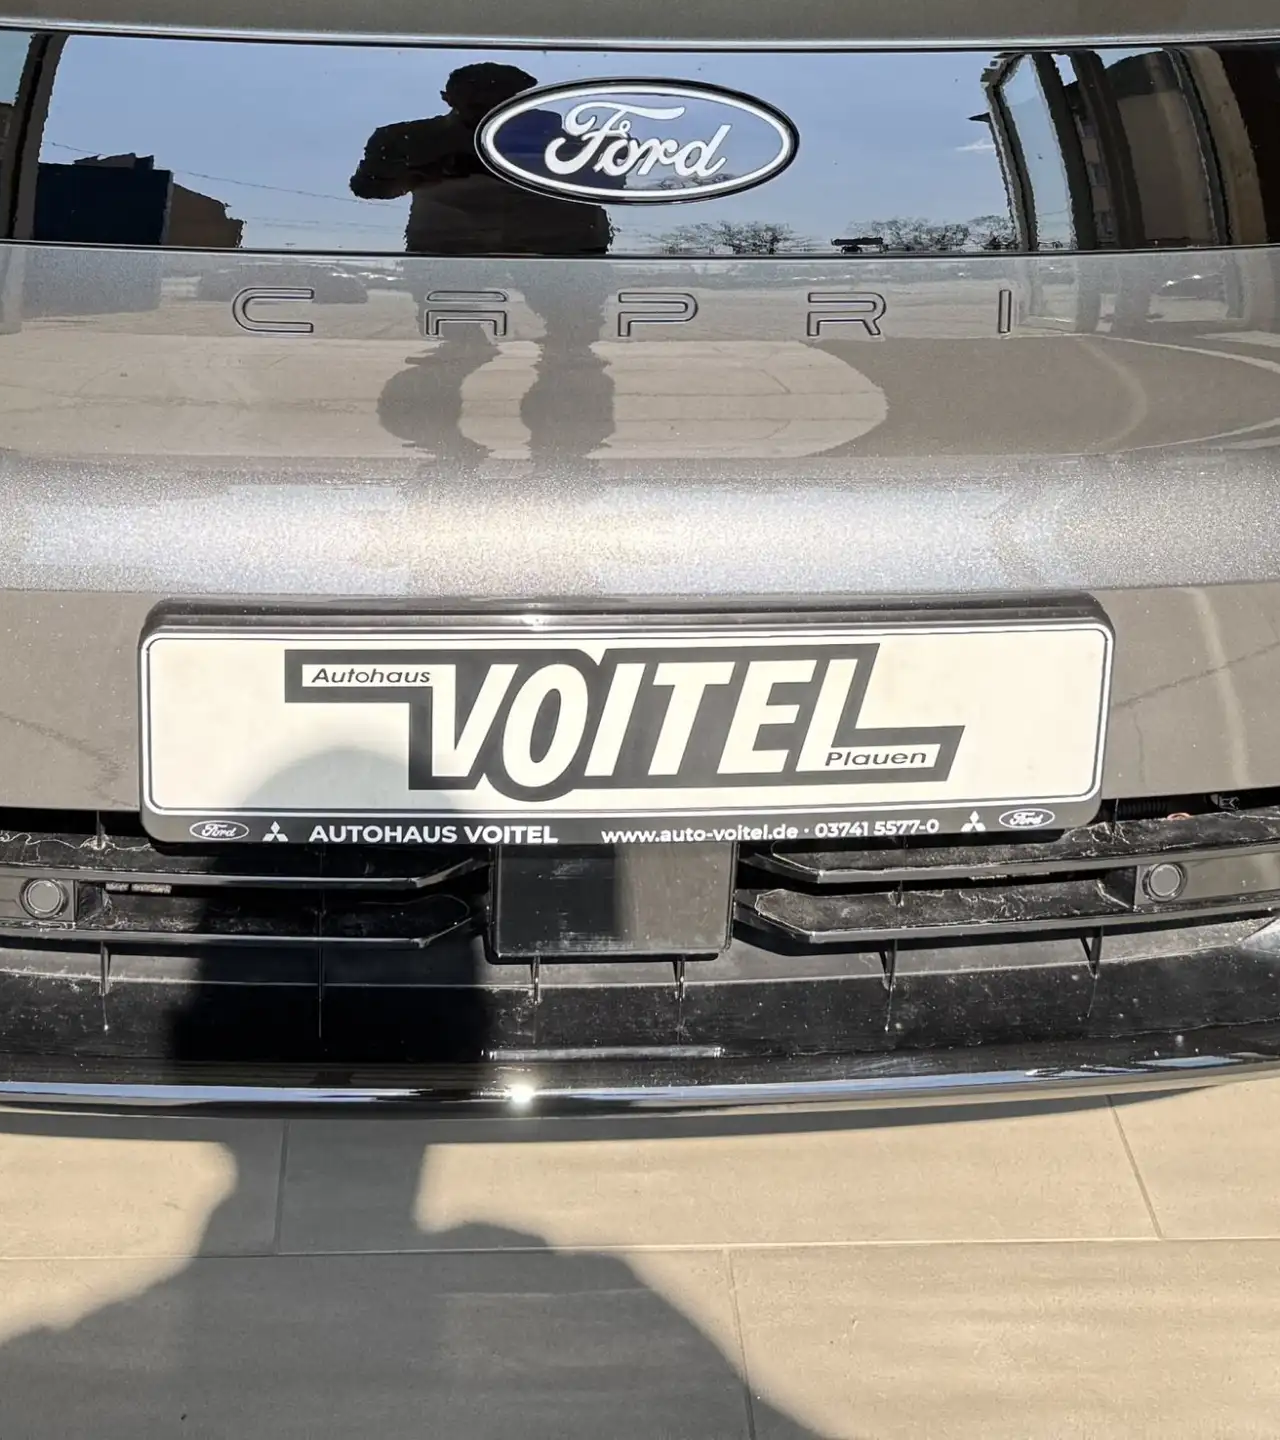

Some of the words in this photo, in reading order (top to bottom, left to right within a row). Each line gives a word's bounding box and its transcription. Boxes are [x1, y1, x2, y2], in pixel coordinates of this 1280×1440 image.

[544, 101, 732, 177] Ford
[231, 287, 1012, 338] CAPRI
[311, 668, 431, 683] Autohaus
[431, 656, 941, 788] VOITEL
[825, 751, 927, 767] Plauen
[201, 823, 237, 838] Ford
[309, 825, 458, 844] AUTOHAUS
[465, 825, 559, 844] VOITEL
[601, 822, 799, 844] www.auto-voitel.de
[814, 821, 869, 839] 03741
[873, 818, 940, 836] 5577-0
